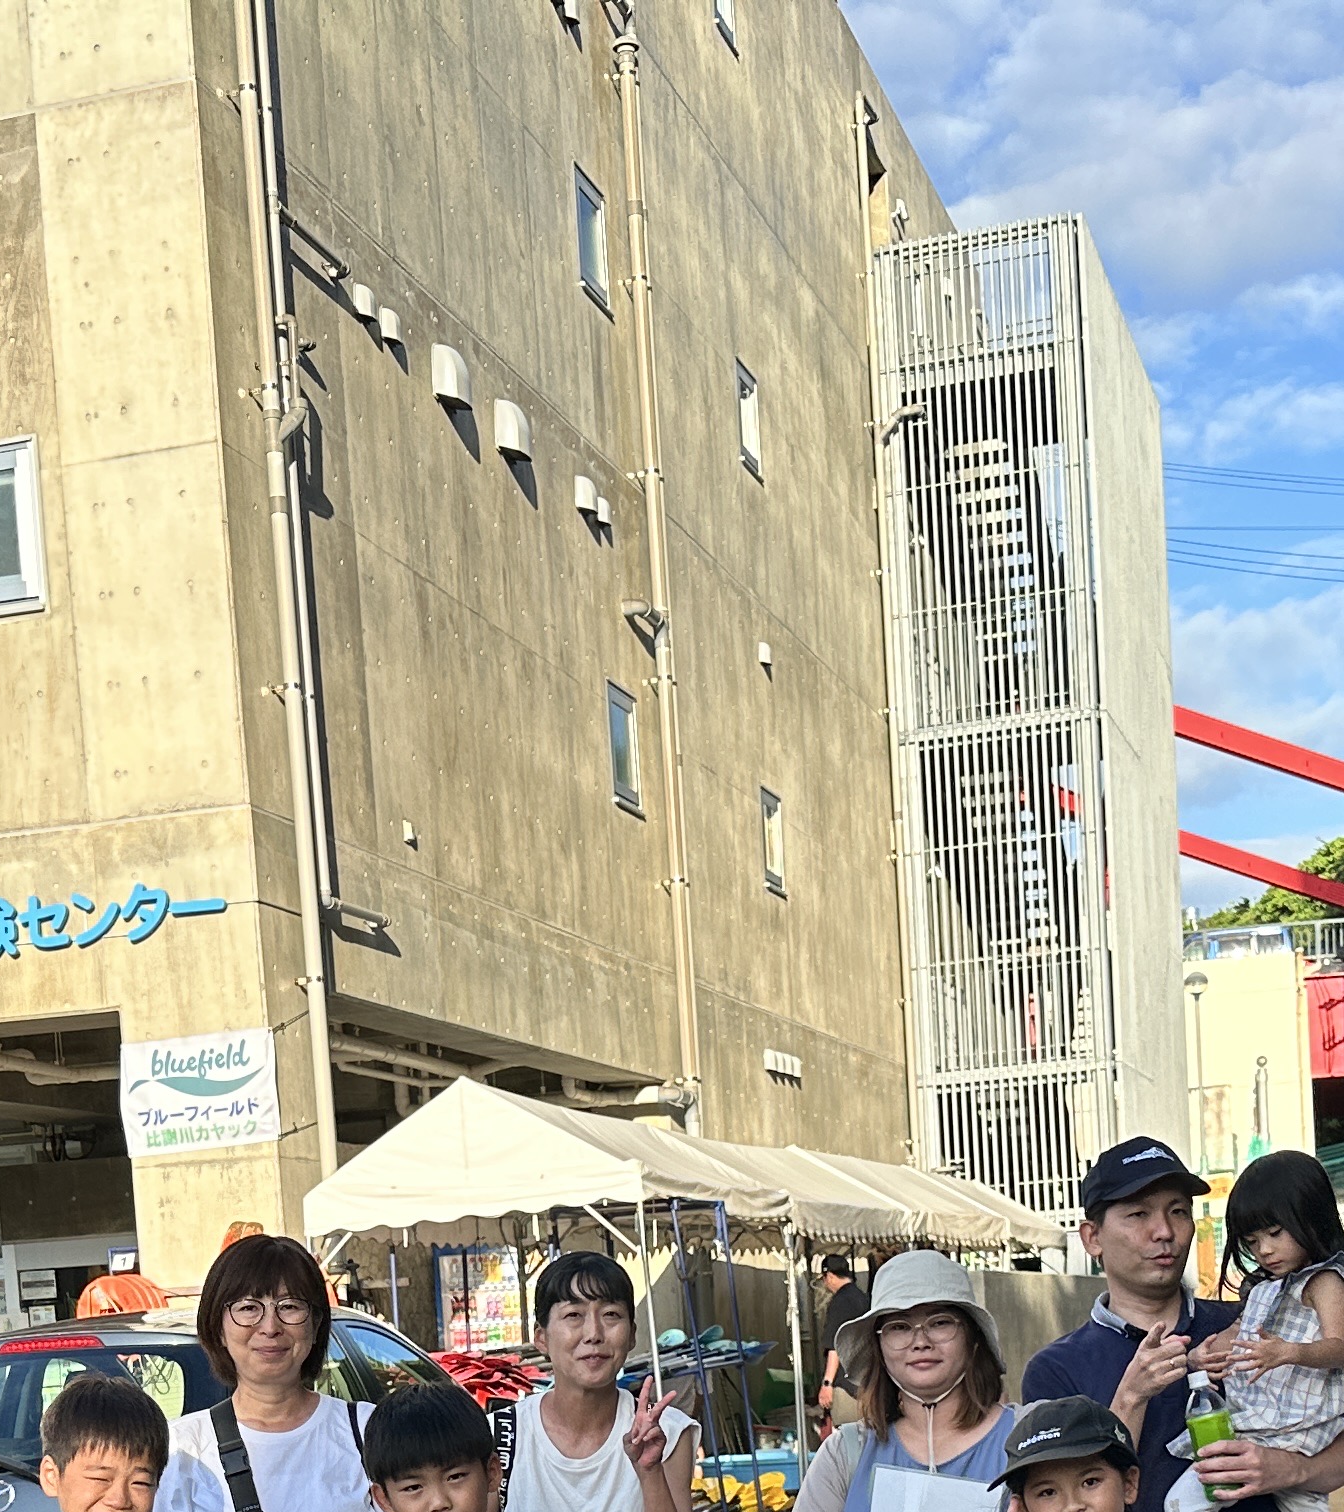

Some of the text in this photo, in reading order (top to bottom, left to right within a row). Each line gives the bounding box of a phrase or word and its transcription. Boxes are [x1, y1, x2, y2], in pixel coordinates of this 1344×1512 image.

[151, 1038, 250, 1079] bluefield
[138, 1097, 259, 1127] ブルーフィールド
[146, 1119, 257, 1149] 比謝川カヤック
